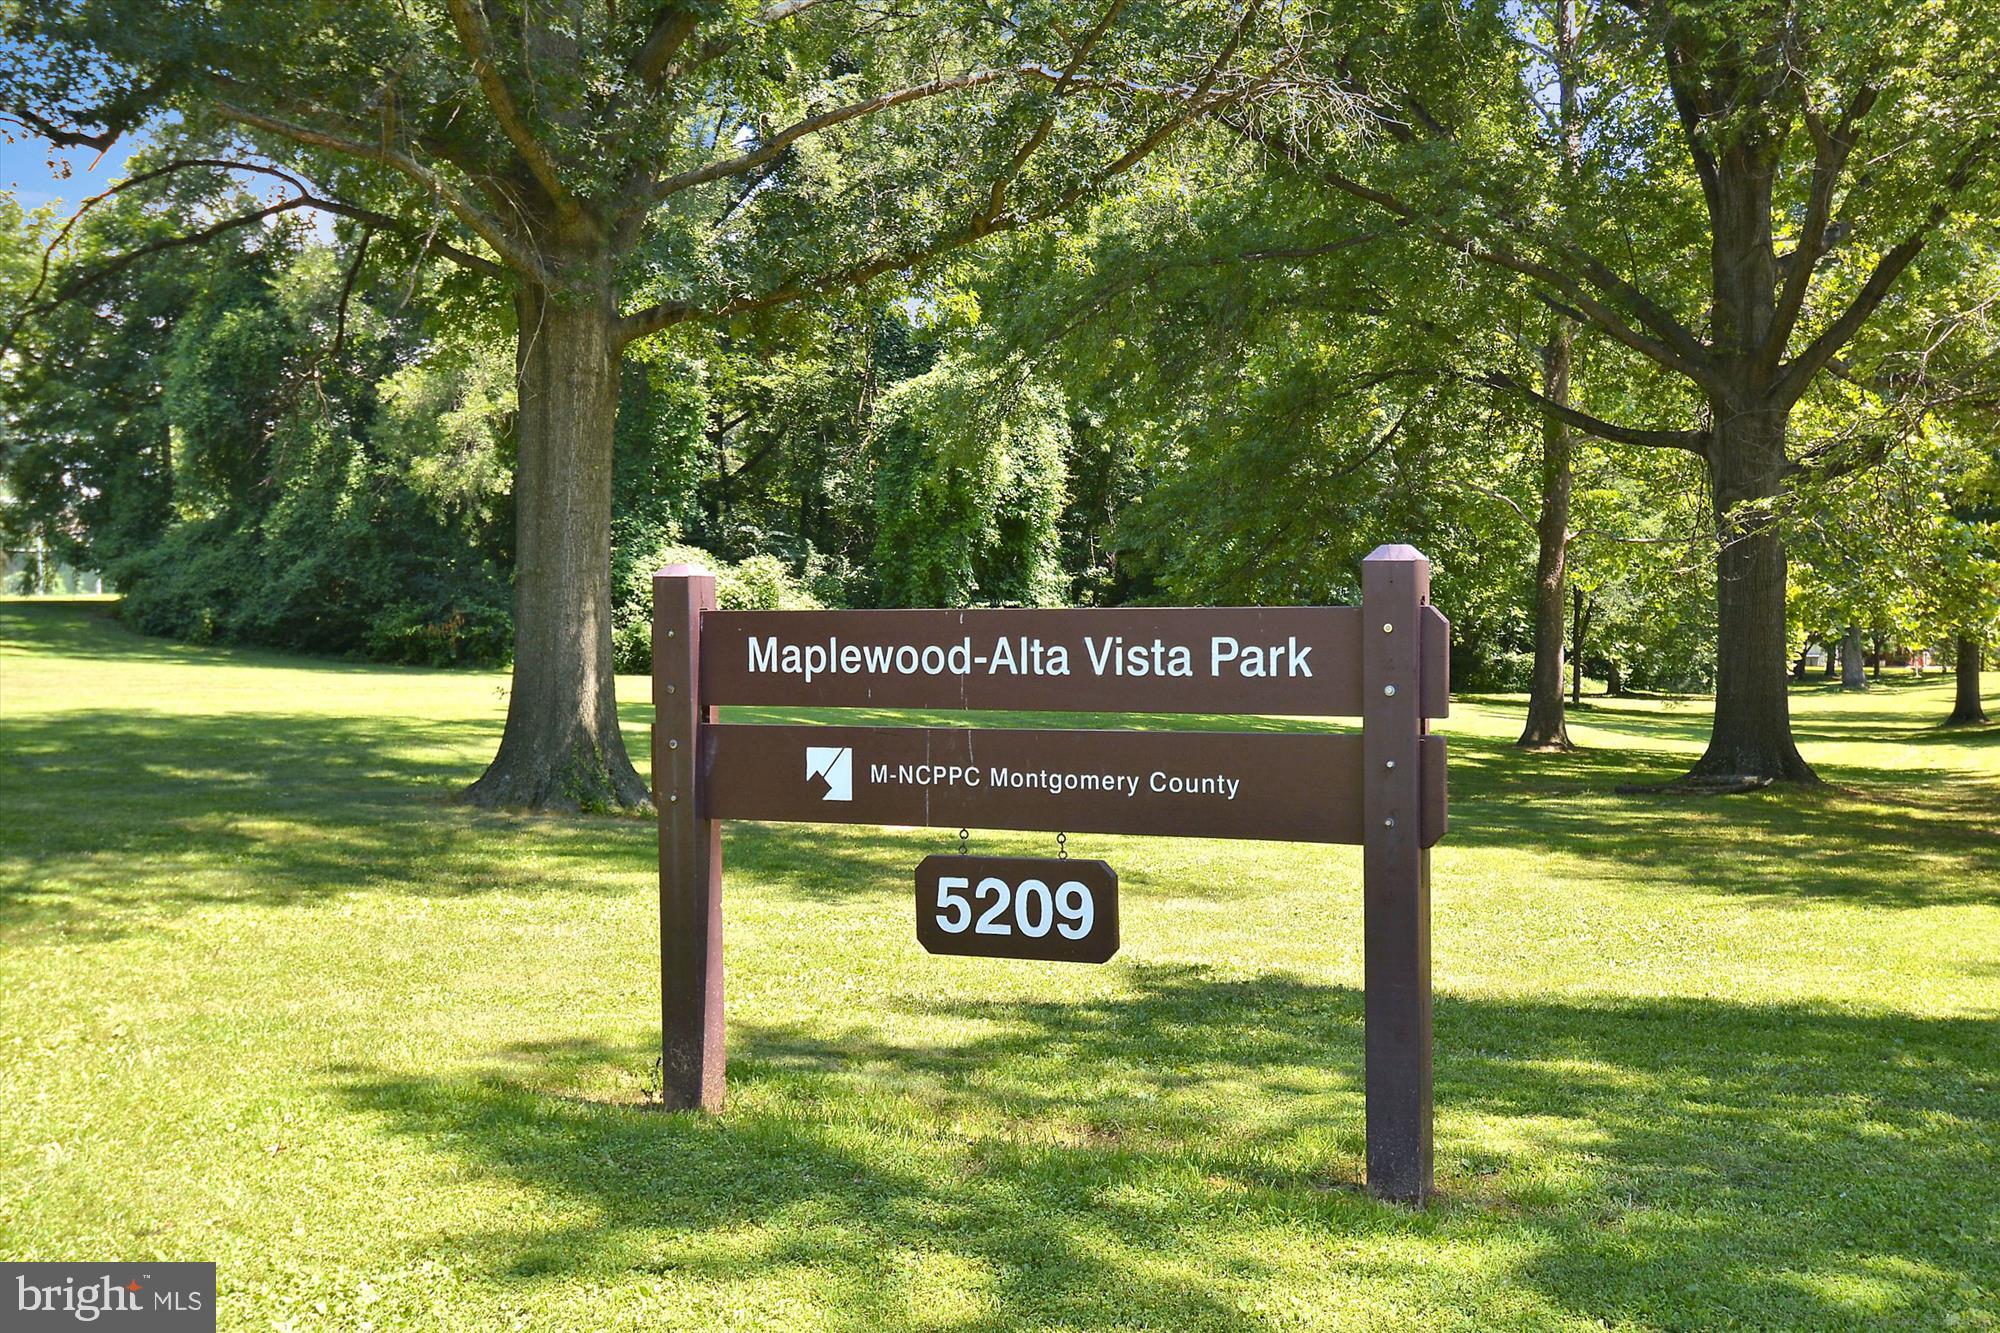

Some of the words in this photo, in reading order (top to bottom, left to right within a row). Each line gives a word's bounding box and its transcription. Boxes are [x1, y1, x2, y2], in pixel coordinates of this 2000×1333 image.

[747, 635, 1071, 683] Maplewood-Alta
[1083, 635, 1193, 677] Vista
[1211, 635, 1313, 678] Park
[870, 763, 980, 787] M-NCPPC
[990, 767, 1140, 797] Montgomery
[1149, 771, 1240, 800] County
[935, 876, 1094, 940] 5209
